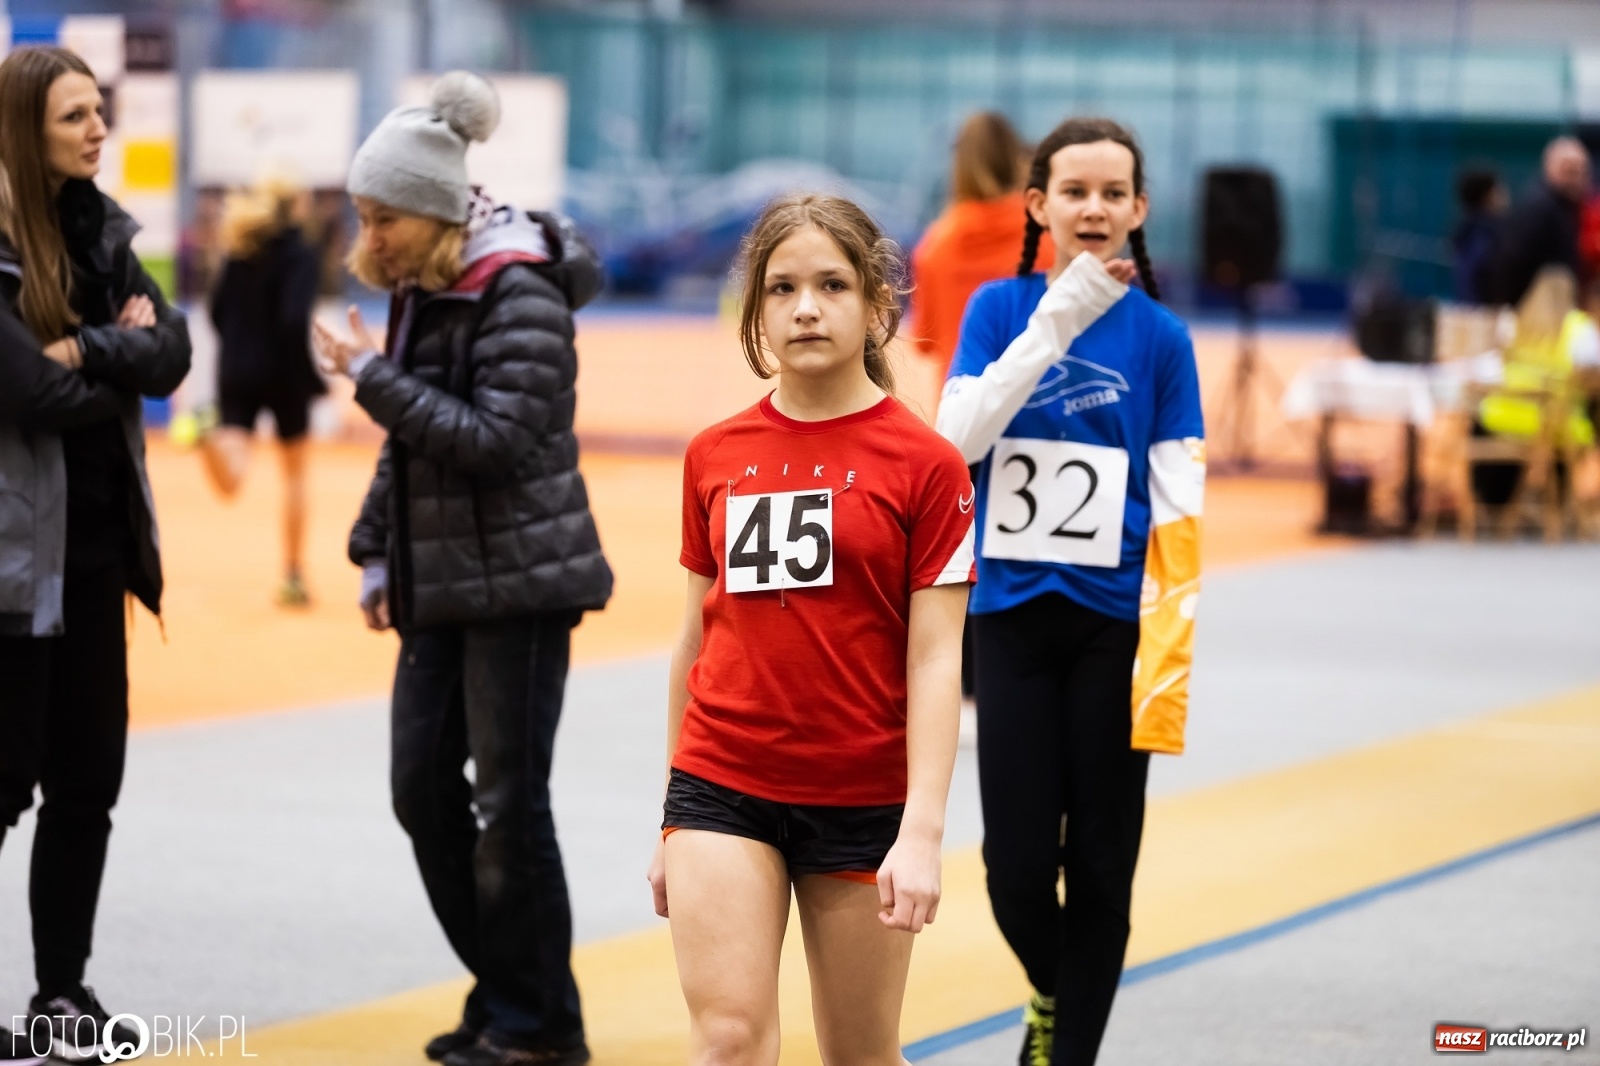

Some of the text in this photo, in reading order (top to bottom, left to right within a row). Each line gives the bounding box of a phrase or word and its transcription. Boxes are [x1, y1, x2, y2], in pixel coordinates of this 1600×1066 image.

[745, 463, 856, 483] NIKE
[996, 454, 1099, 540] 32
[728, 492, 831, 584] 45
